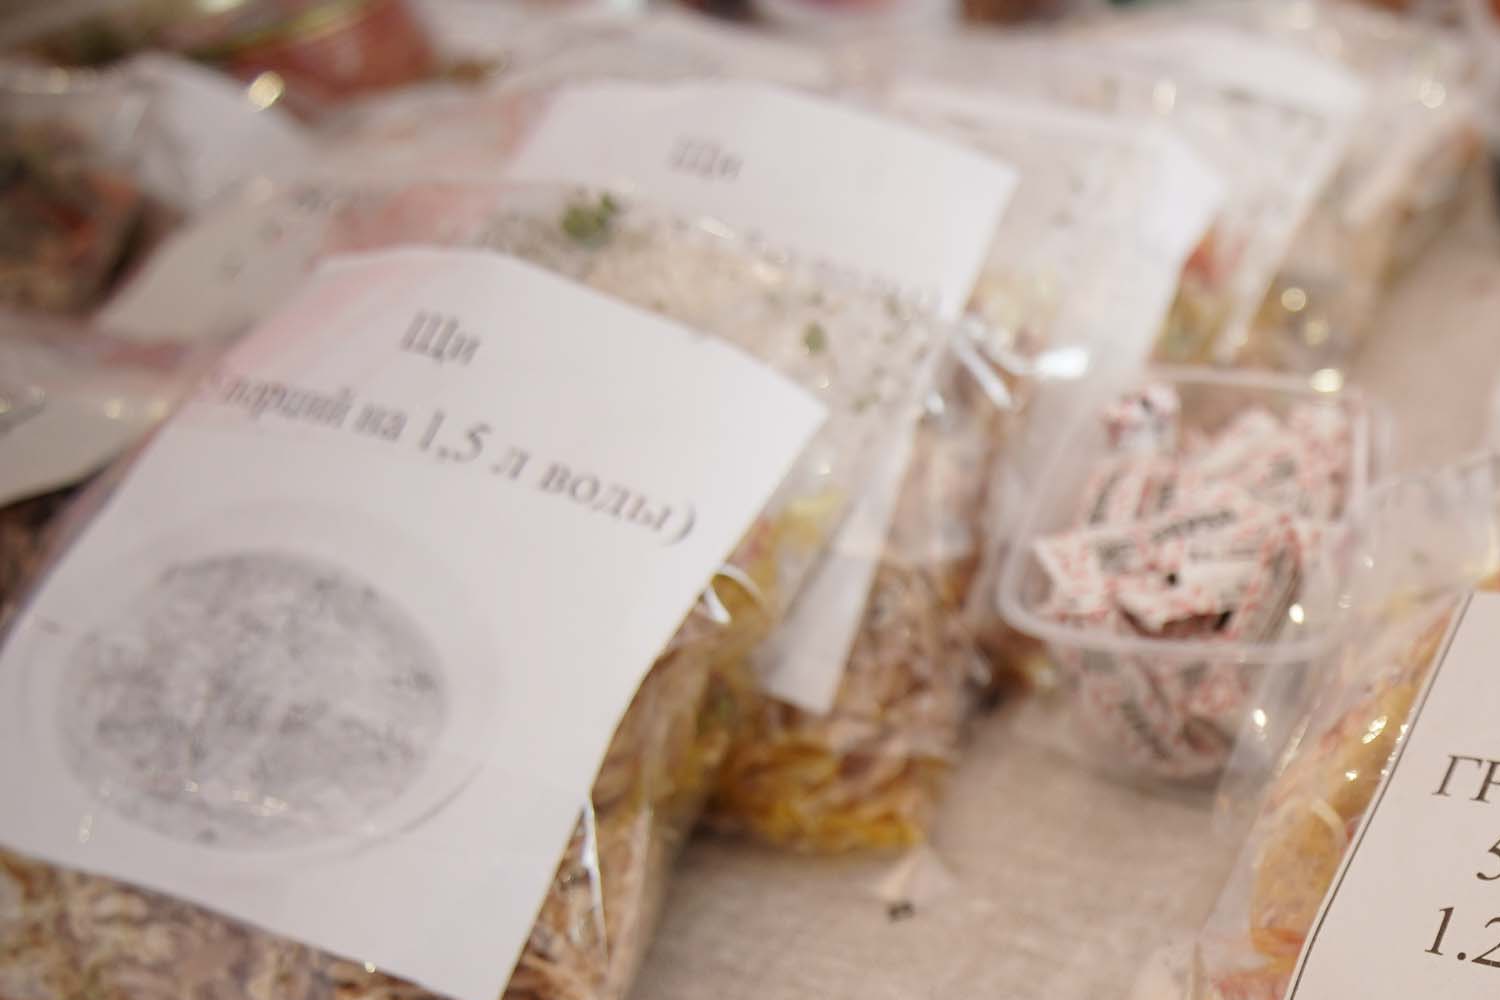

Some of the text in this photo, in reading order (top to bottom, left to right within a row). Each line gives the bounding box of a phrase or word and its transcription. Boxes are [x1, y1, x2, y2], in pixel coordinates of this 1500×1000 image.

[400, 309, 482, 366] Щи
[354, 403, 408, 442] на
[418, 408, 493, 464] 1,5
[491, 445, 530, 481] л
[538, 461, 697, 547] воды)
